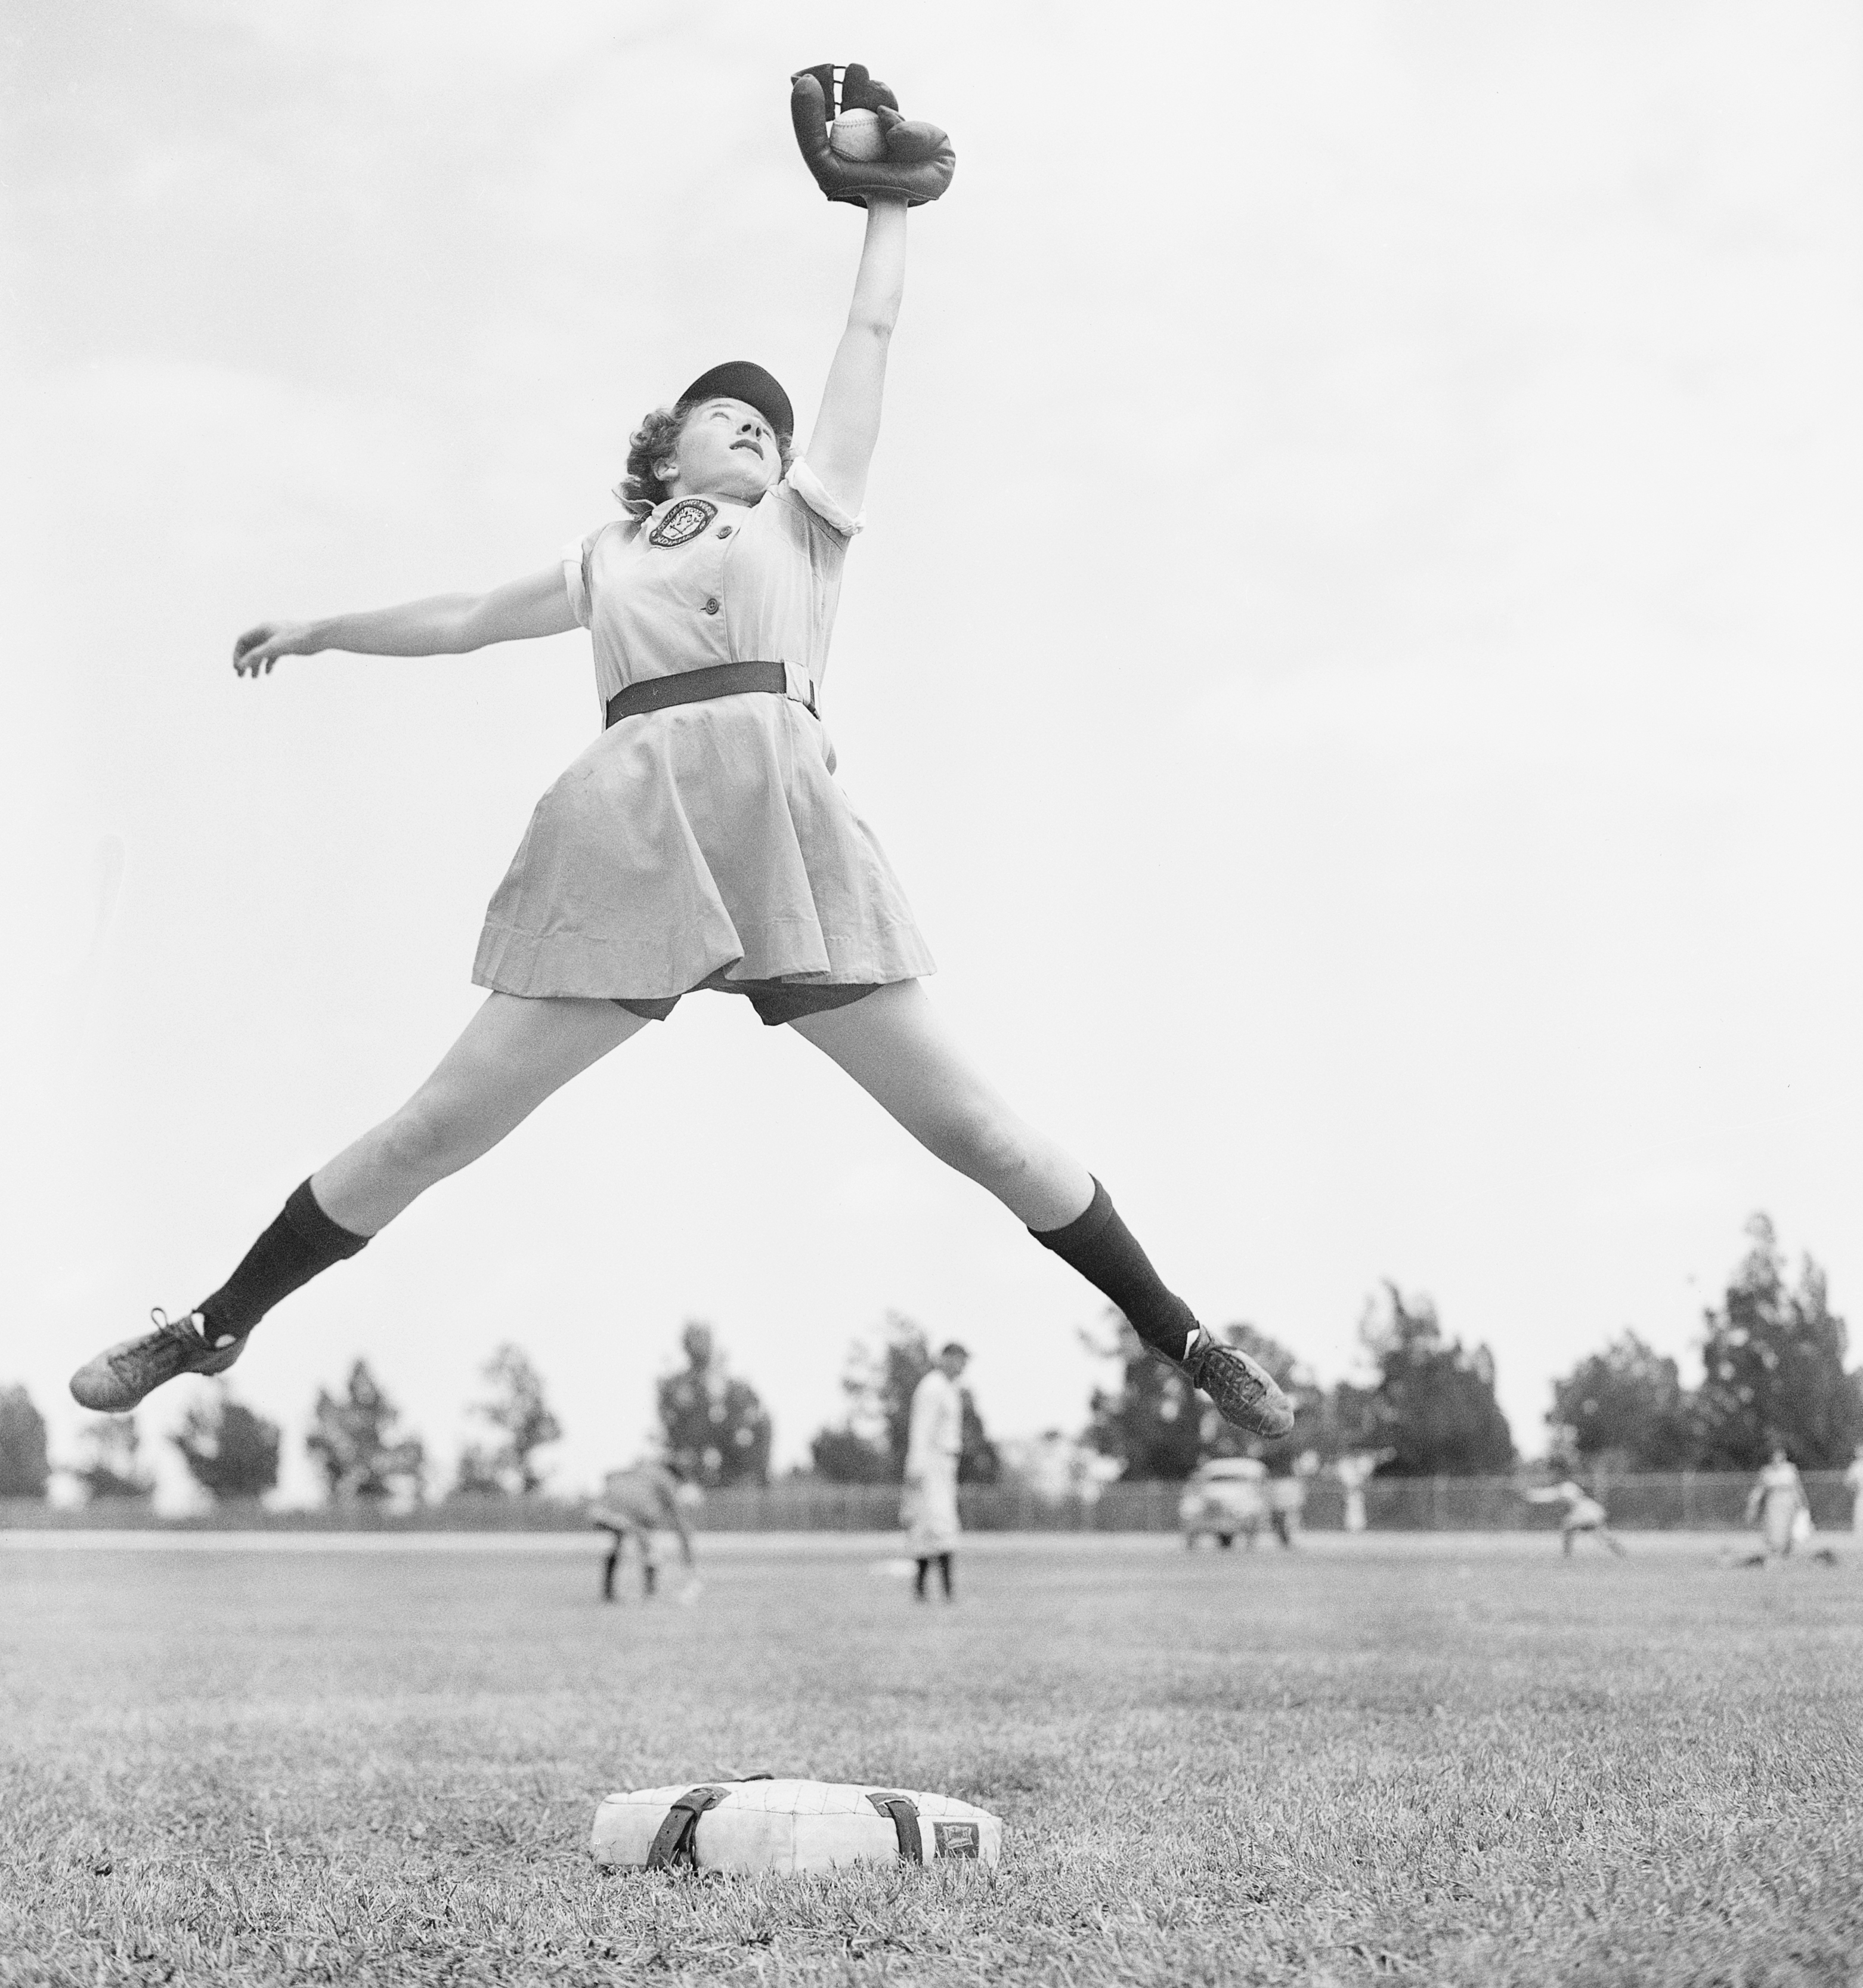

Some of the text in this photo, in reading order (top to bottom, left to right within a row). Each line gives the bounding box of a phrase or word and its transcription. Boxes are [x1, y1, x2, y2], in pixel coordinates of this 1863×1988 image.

[670, 506, 679, 516] OF
[679, 500, 700, 508] FORT
[700, 501, 715, 516] WAY
